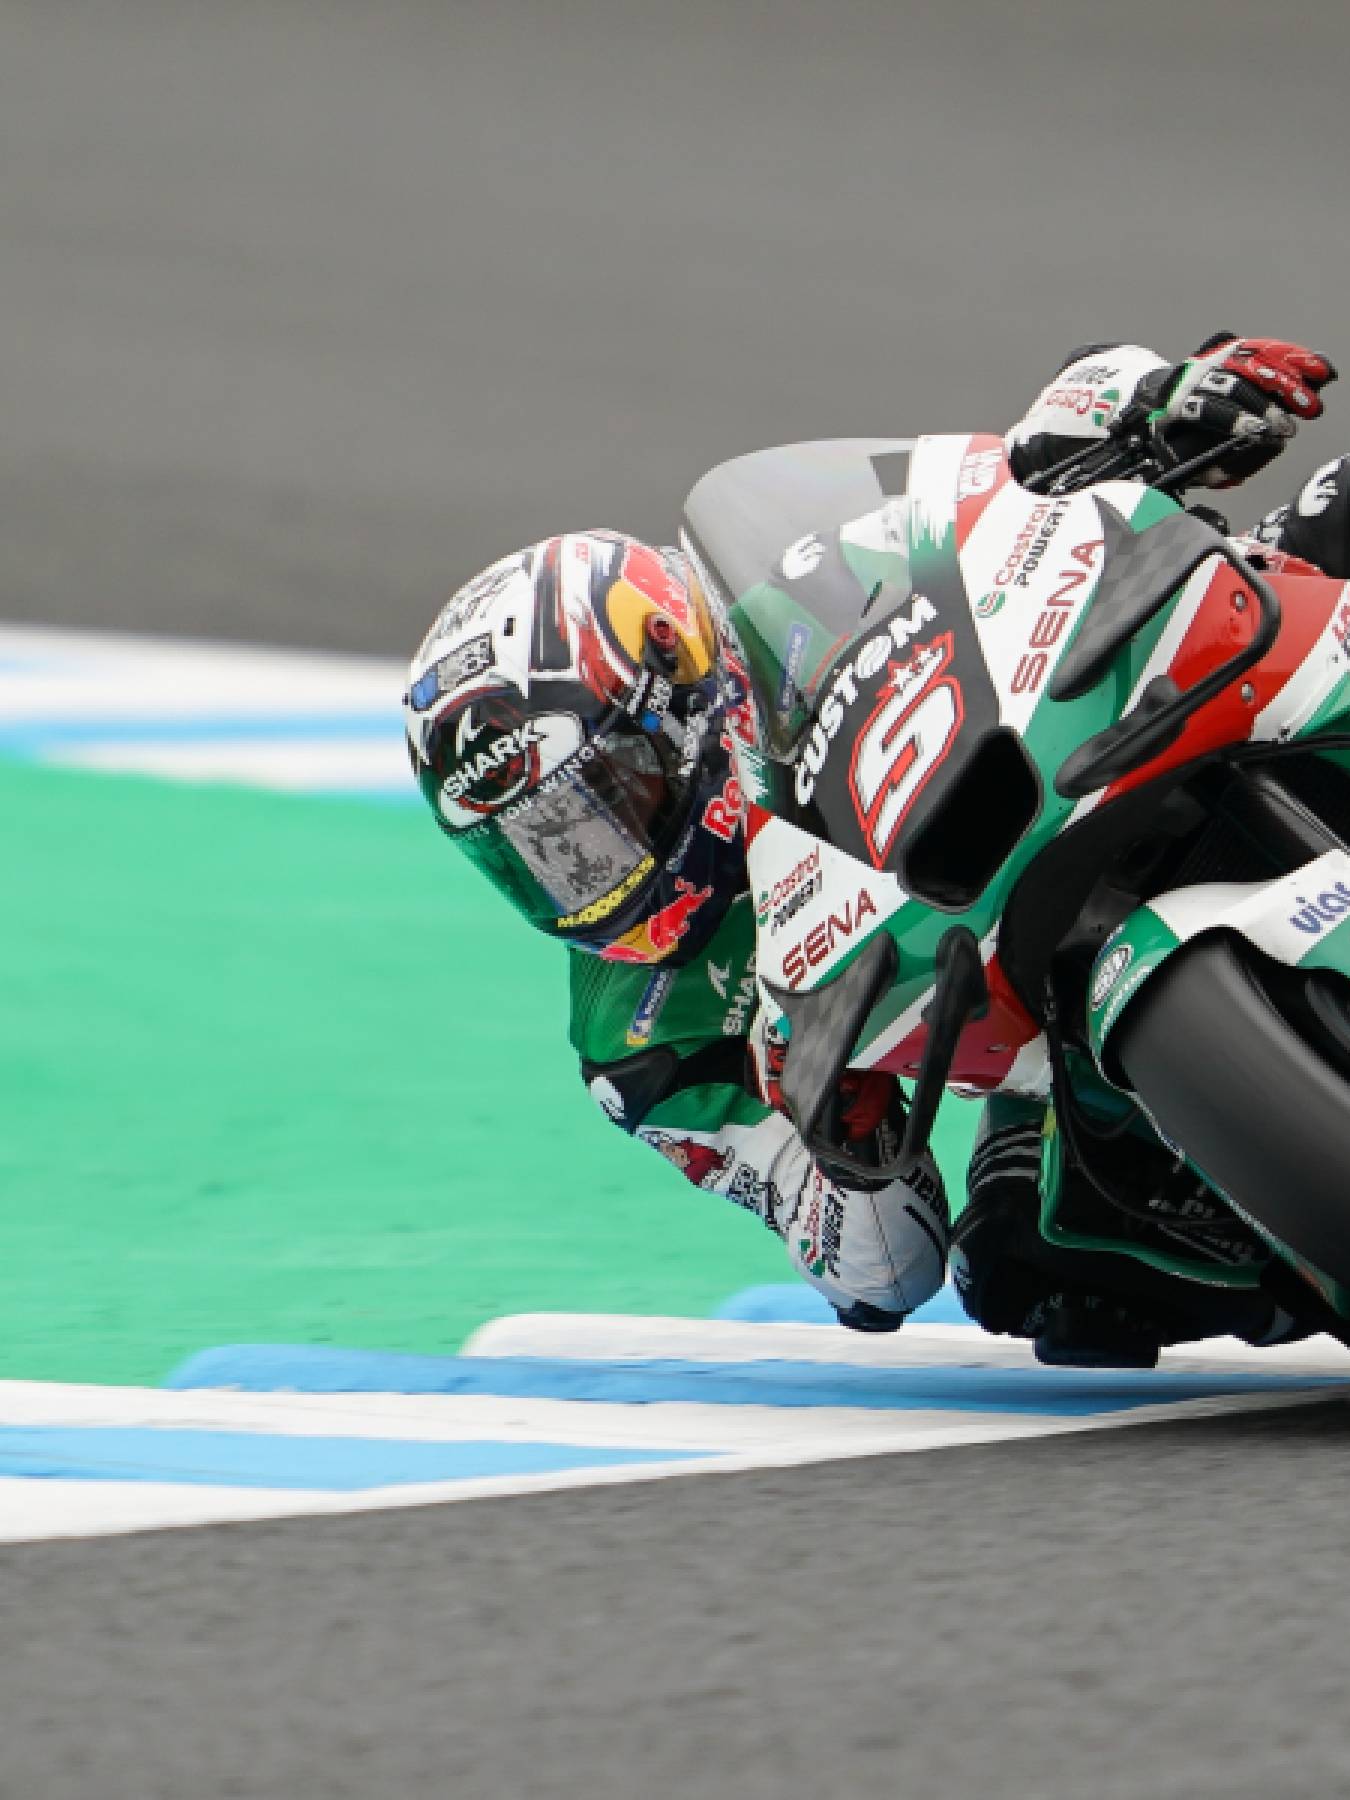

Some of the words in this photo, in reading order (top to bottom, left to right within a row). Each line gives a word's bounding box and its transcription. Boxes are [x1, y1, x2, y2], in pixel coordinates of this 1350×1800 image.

[994, 502, 1051, 587] Castrol
[1010, 540, 1104, 696] SENA
[794, 593, 938, 806] CUSTOM
[847, 630, 965, 872] 5
[443, 718, 549, 800] SHARK
[782, 887, 878, 990] SENA
[722, 950, 757, 1036] SHA
